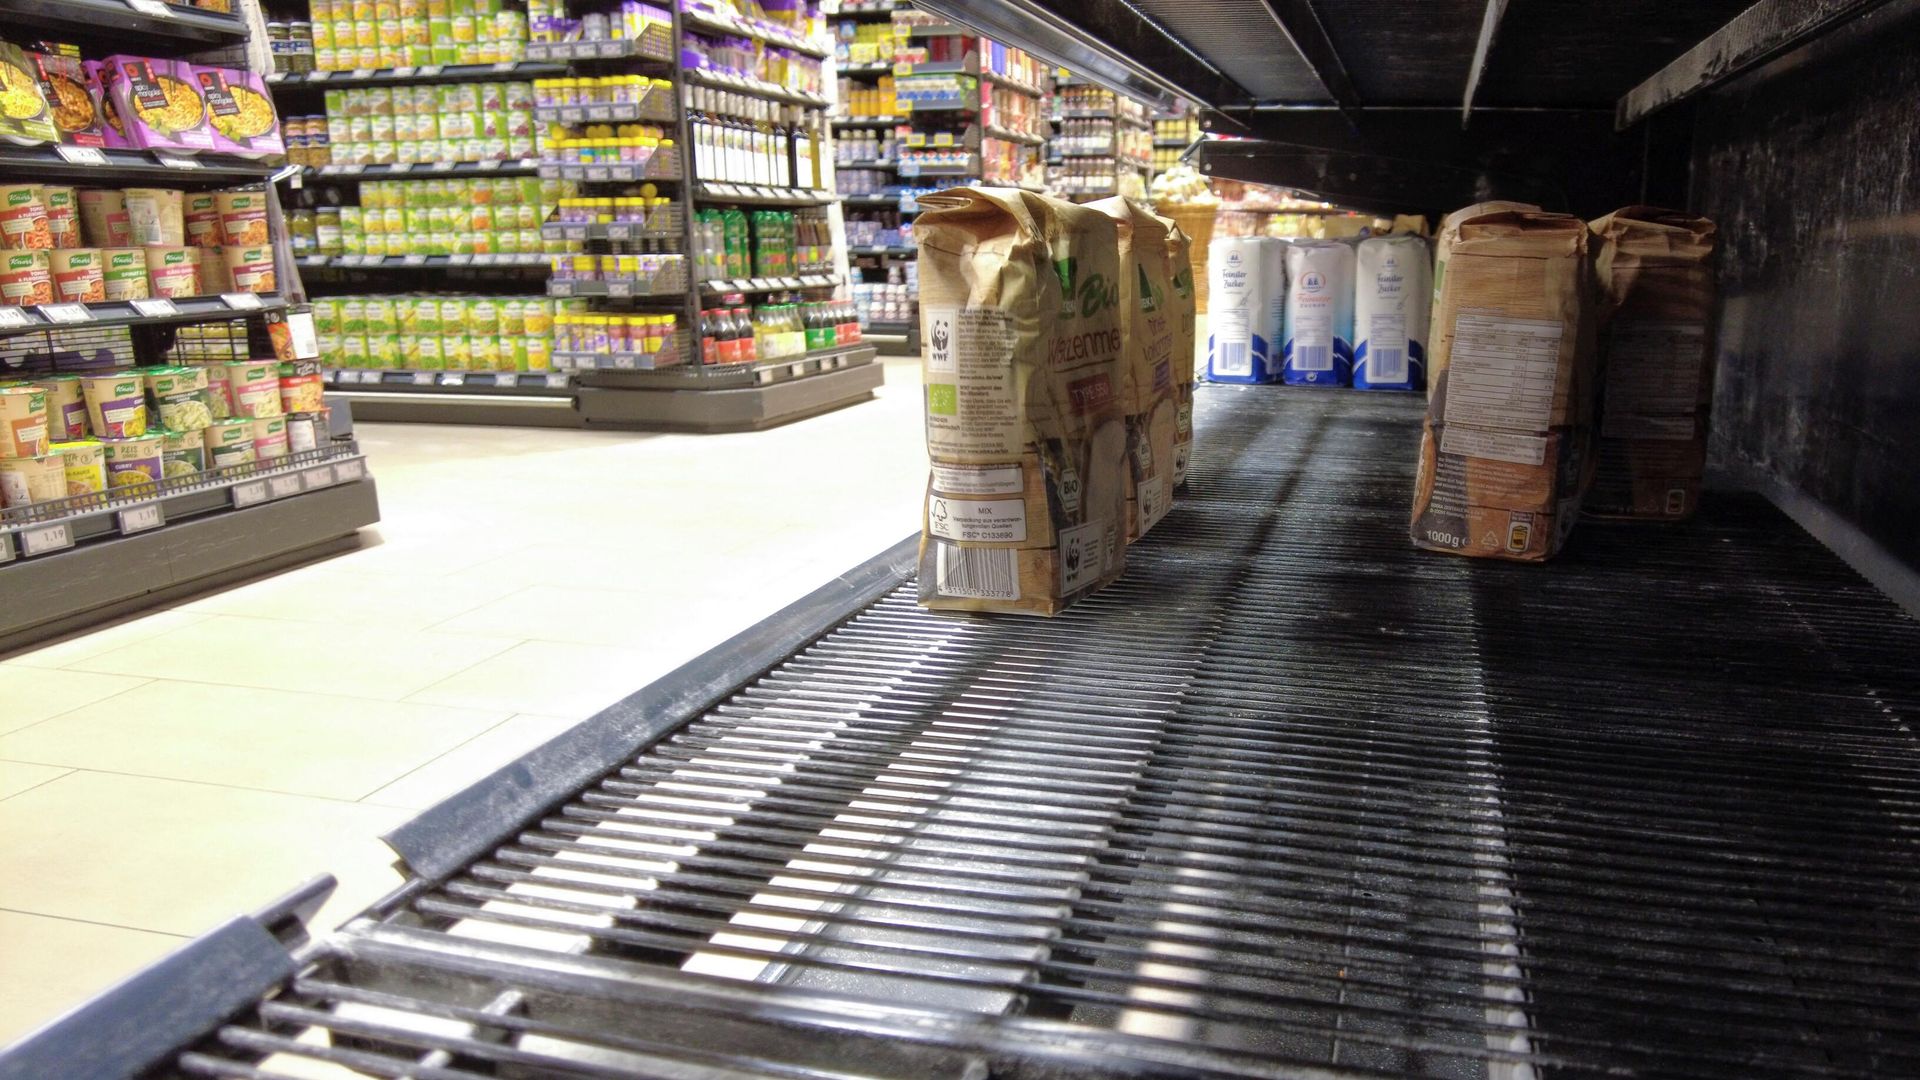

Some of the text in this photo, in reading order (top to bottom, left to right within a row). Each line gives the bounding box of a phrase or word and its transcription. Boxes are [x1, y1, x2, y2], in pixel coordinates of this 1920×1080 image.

[9, 190, 31, 201] Knorr
[10, 257, 32, 266] Knorr
[71, 256, 91, 265] Knorr
[113, 256, 133, 264] Knorr
[1223, 280, 1245, 289] Zucker
[1077, 273, 1120, 319] Bio
[932, 353, 947, 361] WWF
[116, 385, 136, 393] Knorr
[121, 446, 138, 454] REIS
[1064, 479, 1078, 493] BIO
[978, 507, 992, 515] MIX
[935, 522, 950, 531] FSC
[44, 529, 64, 543] 1.19
